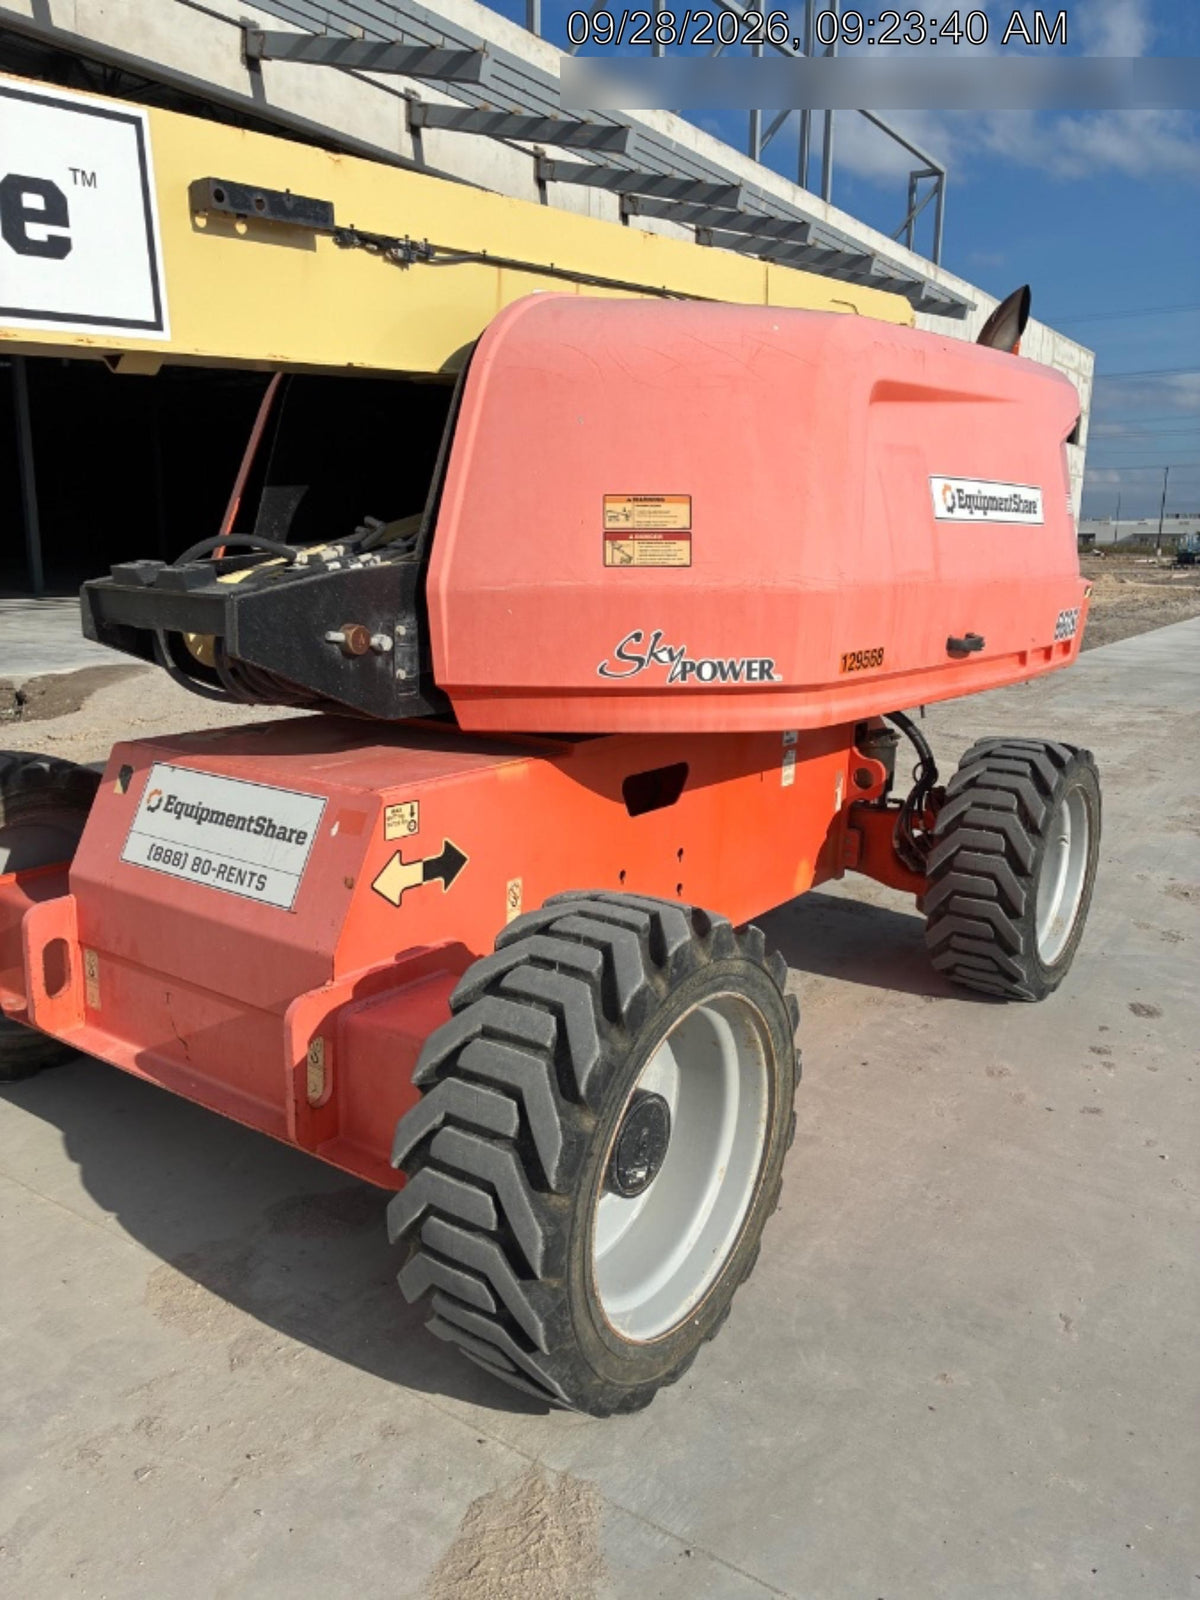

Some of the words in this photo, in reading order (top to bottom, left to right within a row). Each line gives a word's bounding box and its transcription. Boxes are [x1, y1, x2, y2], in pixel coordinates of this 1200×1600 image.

[956, 488, 1038, 516] EquipmentShare
[163, 794, 308, 845] EquipmentShare
[191, 858, 268, 892] 80-RENTS
